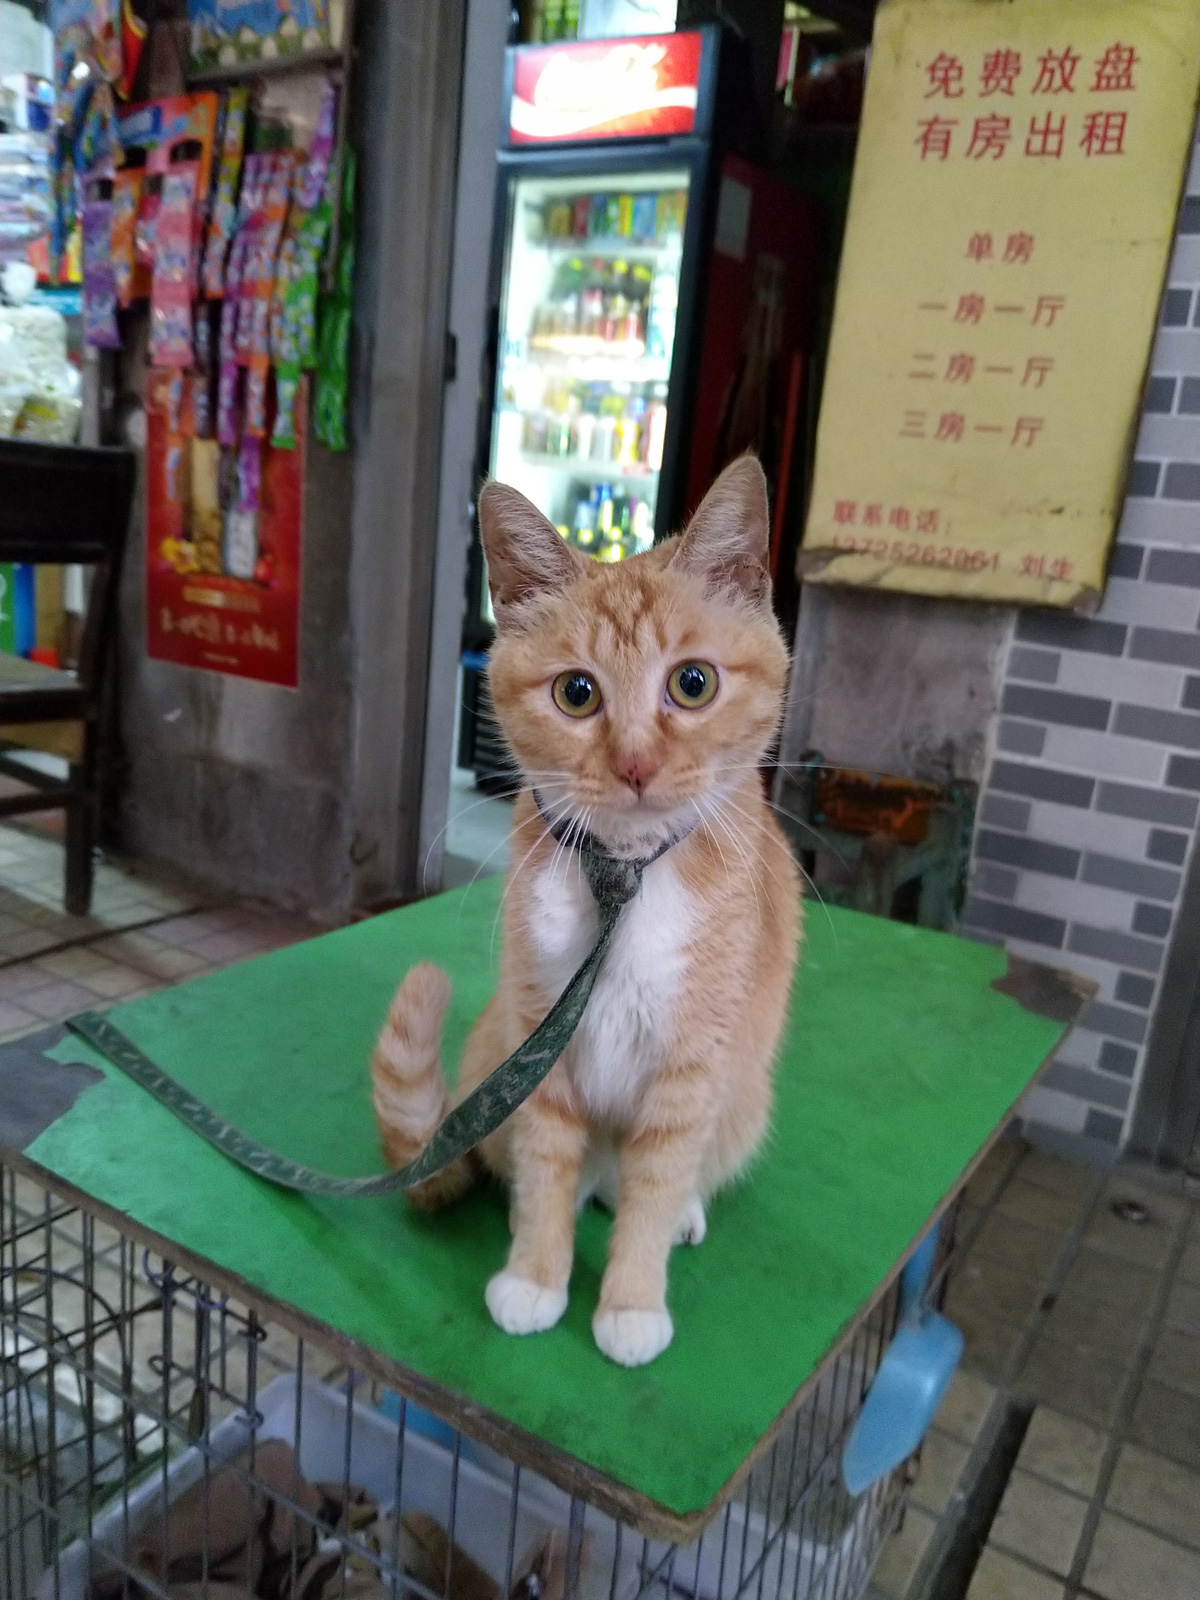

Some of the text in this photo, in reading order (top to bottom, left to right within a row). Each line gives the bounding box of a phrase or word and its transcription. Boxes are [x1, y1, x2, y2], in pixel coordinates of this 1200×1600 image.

[924, 41, 1140, 99] 免费放盘
[914, 111, 1127, 161] 有房出租
[966, 231, 1035, 264] 单房
[918, 293, 1065, 327] 一房一厅
[907, 352, 1055, 388] 二房一厅
[899, 410, 1044, 448] 三房一厅
[1020, 553, 1074, 580] 刘生
